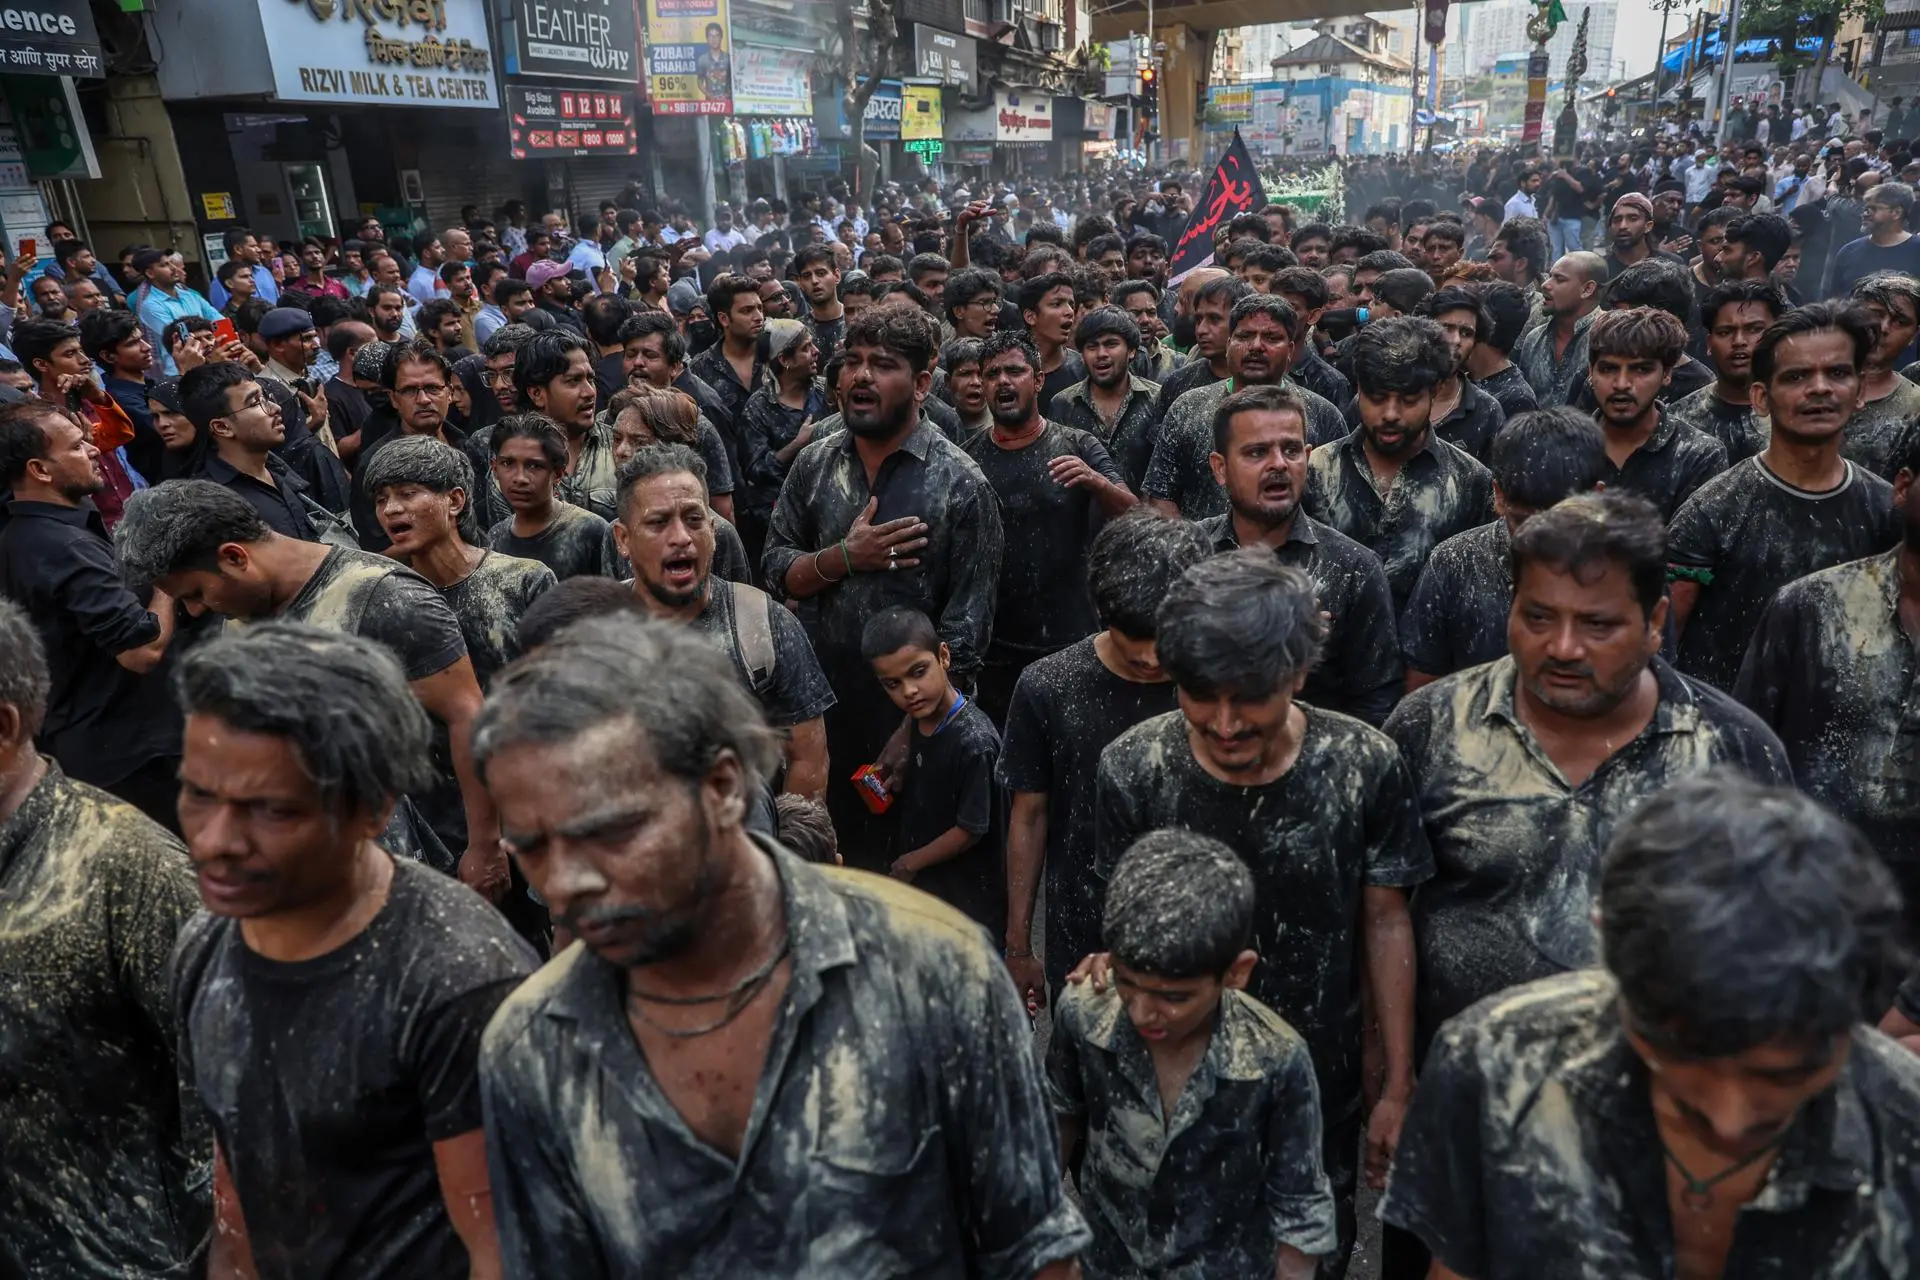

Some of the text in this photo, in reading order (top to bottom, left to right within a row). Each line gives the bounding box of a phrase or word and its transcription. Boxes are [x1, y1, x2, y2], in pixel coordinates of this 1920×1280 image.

[524, 3, 611, 47] LEATHER
[590, 46, 629, 71] WAY
[653, 46, 695, 60] ZUBAIR
[10, 47, 41, 66] आणि
[44, 53, 71, 72] सुपर
[73, 49, 98, 76] स्टोर
[654, 61, 696, 73] SHAHAB
[299, 67, 489, 101] RIZVI MILK & TEA CENTER
[659, 77, 687, 91] 96%
[527, 105, 556, 116] Available
[564, 98, 621, 114] 11 12 13 14
